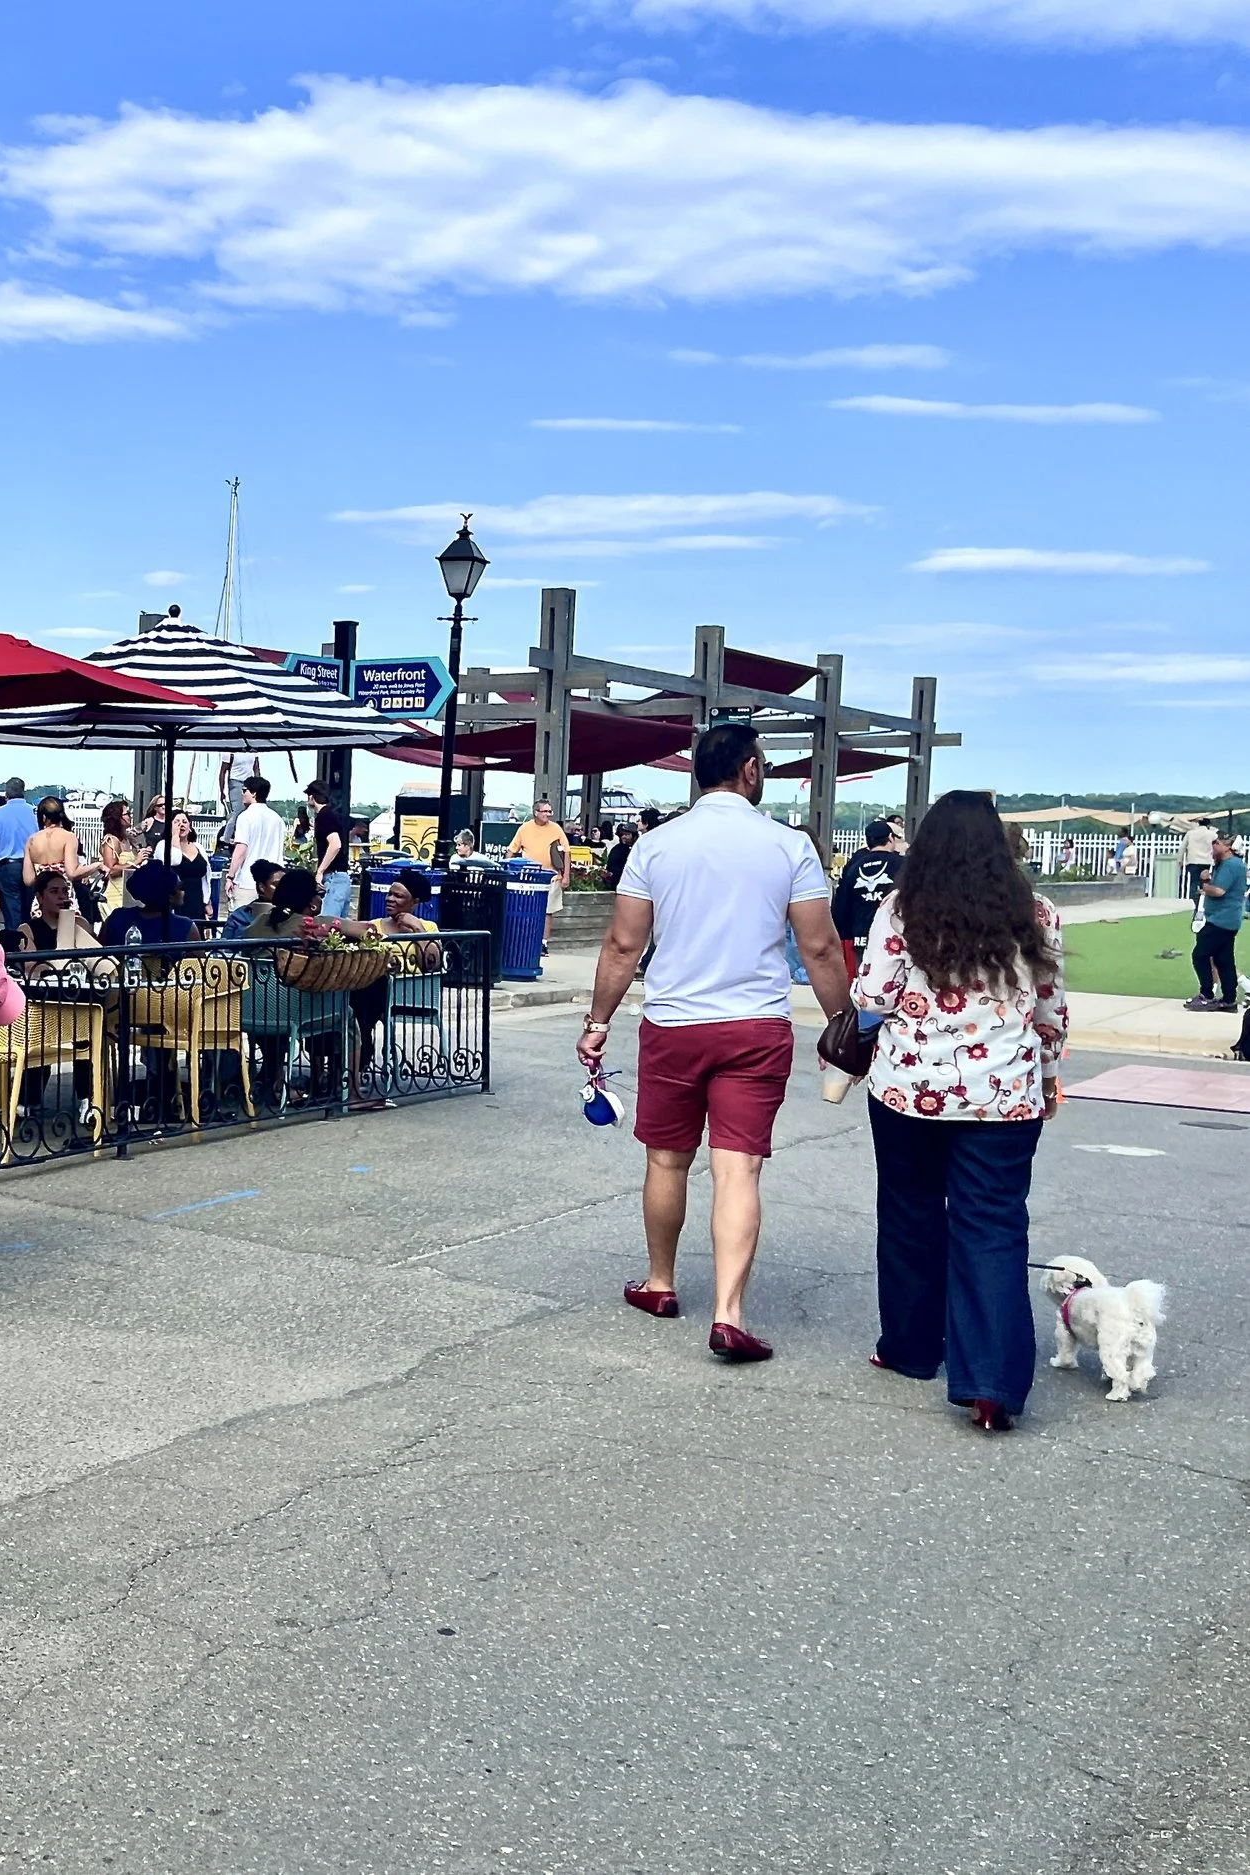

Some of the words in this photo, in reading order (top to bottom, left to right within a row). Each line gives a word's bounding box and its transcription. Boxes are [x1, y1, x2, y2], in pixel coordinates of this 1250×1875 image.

[300, 663, 316, 680] King
[317, 664, 338, 680] Street
[363, 667, 426, 681] Waterfront
[484, 842, 510, 853] Water
[853, 937, 867, 947] RE
